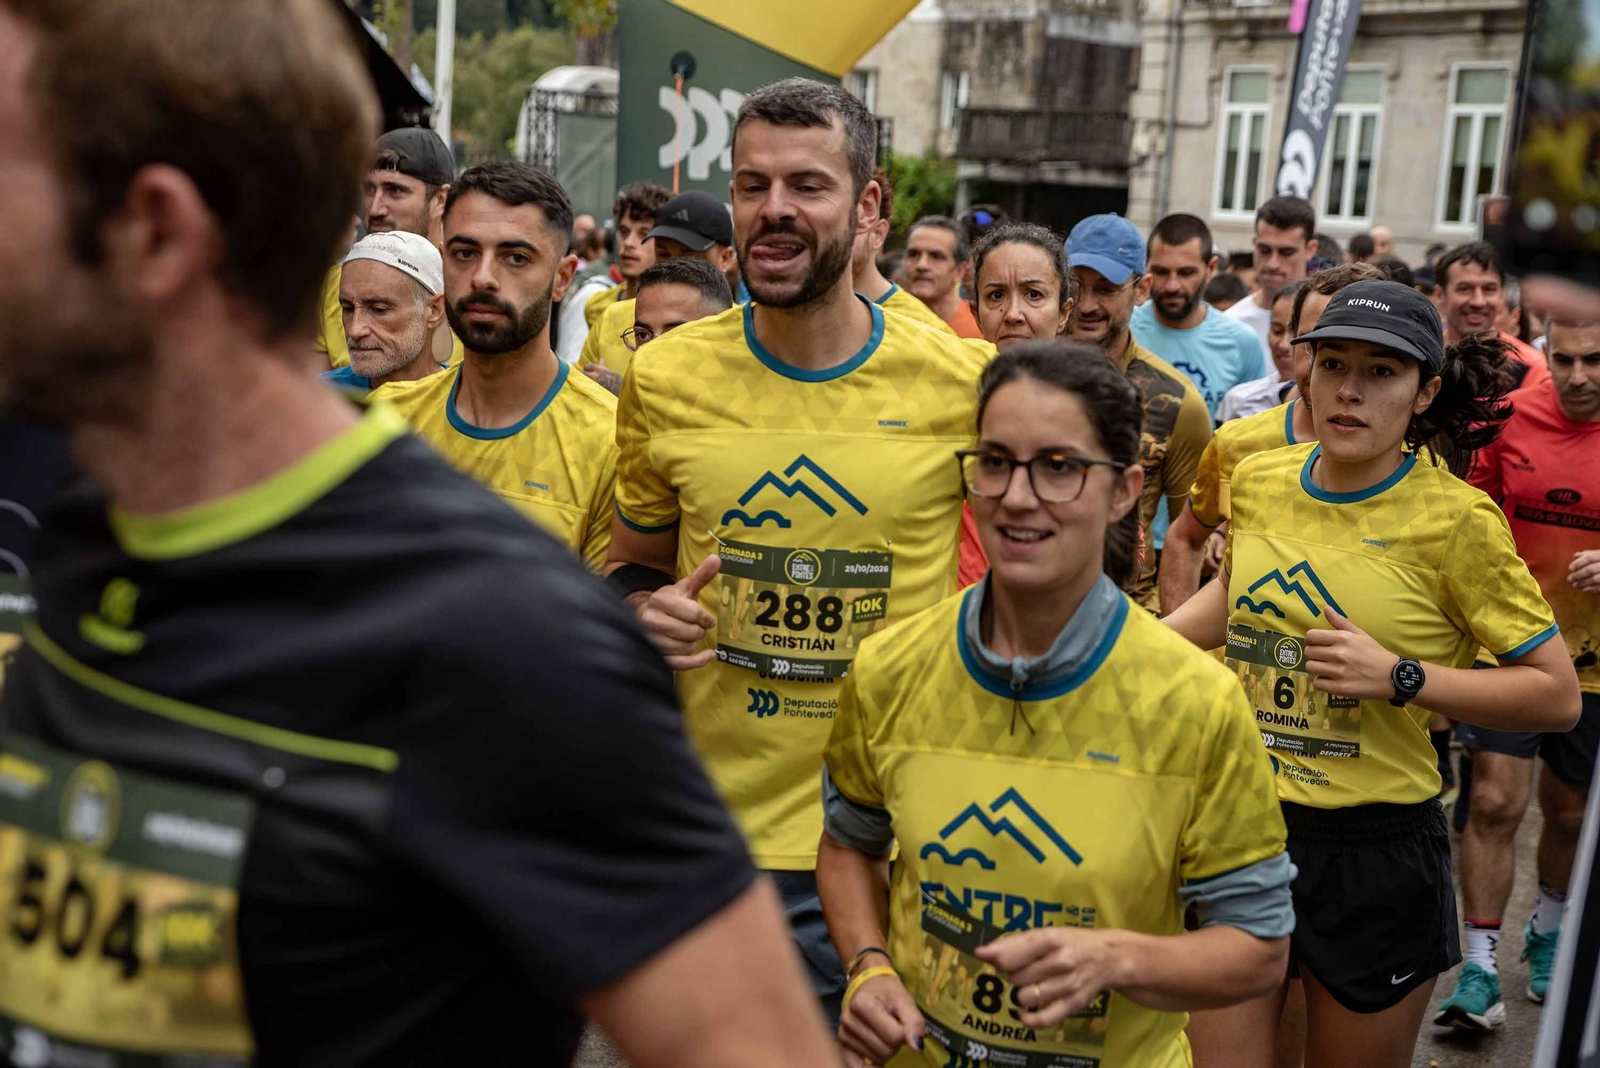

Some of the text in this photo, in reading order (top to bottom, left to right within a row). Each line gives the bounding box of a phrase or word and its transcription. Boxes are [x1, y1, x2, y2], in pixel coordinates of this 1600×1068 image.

[1348, 298, 1390, 312] KIPRUN
[720, 545, 763, 560] XORNADA 3
[756, 590, 843, 633] 288
[854, 597, 883, 614] 10K
[761, 633, 835, 651] CRISTIAN
[1228, 632, 1252, 644] XORNADA
[1274, 676, 1295, 709] 6
[1256, 710, 1309, 729] ROMINA
[1276, 737, 1304, 746] Deputación
[1276, 742, 1304, 750] Pontevedra
[10, 859, 140, 981] 504
[962, 1013, 1037, 1042] ANDREA
